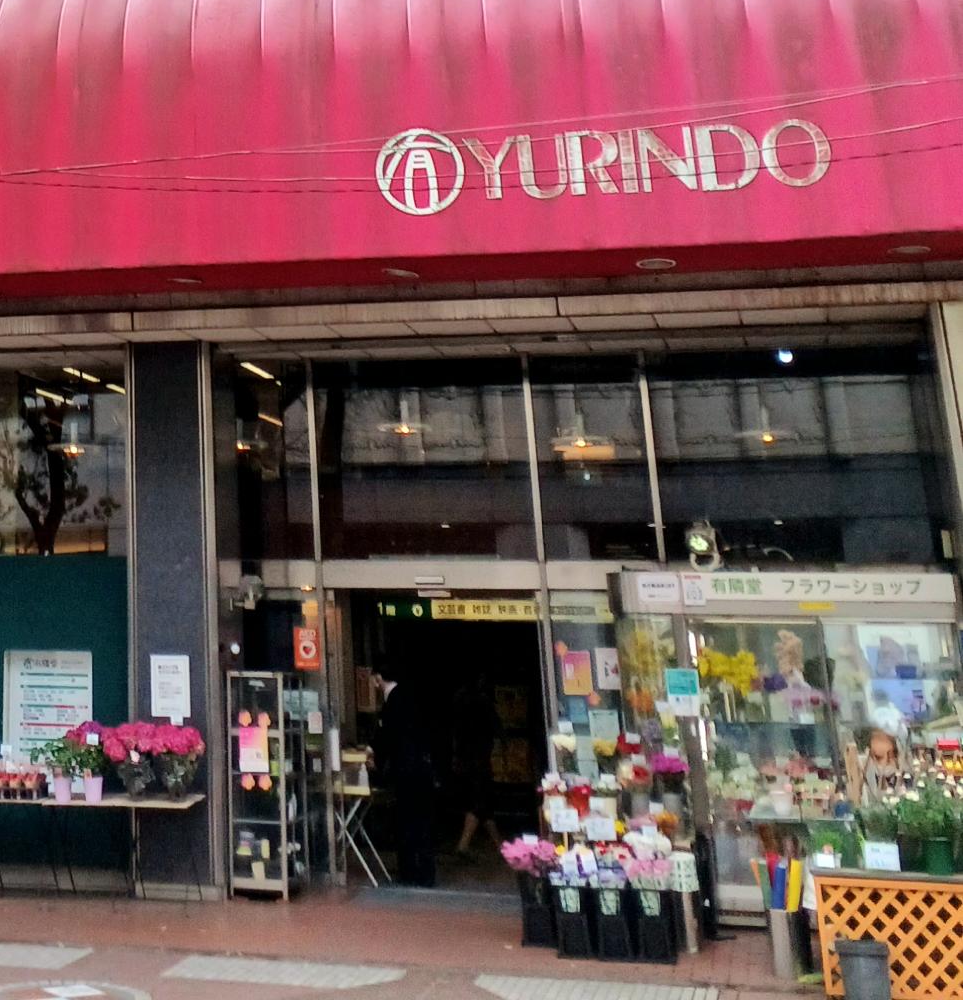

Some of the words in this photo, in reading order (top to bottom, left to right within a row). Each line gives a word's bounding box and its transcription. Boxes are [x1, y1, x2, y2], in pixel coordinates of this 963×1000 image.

[461, 118, 832, 200] YURINDO
[711, 578, 763, 595] 有隣堂
[782, 578, 923, 596] フラワーショップ
